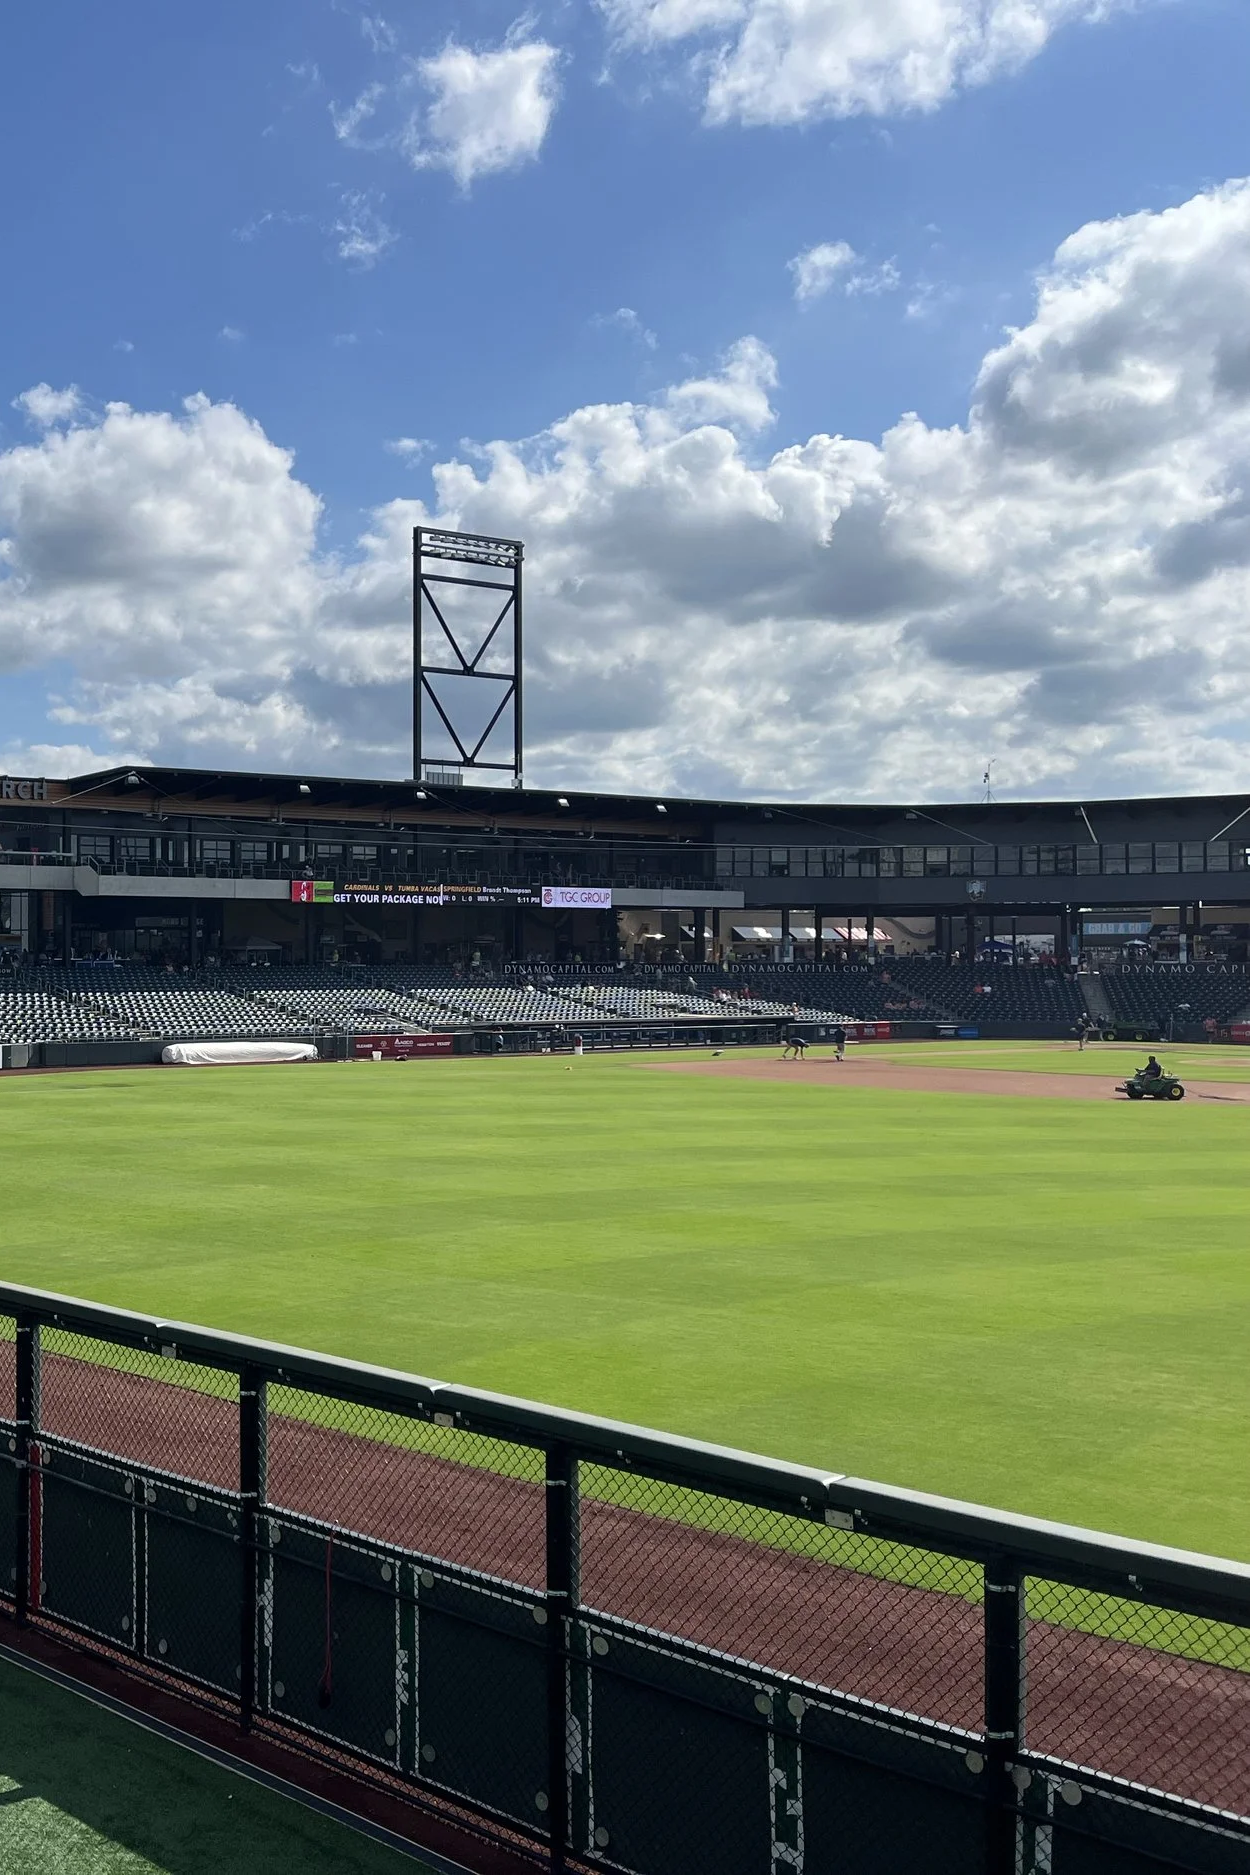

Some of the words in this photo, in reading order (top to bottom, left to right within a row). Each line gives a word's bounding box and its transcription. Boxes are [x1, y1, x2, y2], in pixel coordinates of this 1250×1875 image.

[333, 893, 351, 903] GET
[353, 893, 380, 903] YOUR
[381, 894, 424, 904] PACKAGE
[560, 891, 579, 903] TGC
[581, 892, 611, 904] GROUP
[1088, 923, 1115, 933] GRAB
[1128, 923, 1142, 933] GO
[683, 964, 716, 973] CAPITAL
[1121, 964, 1196, 974] DYNAMO
